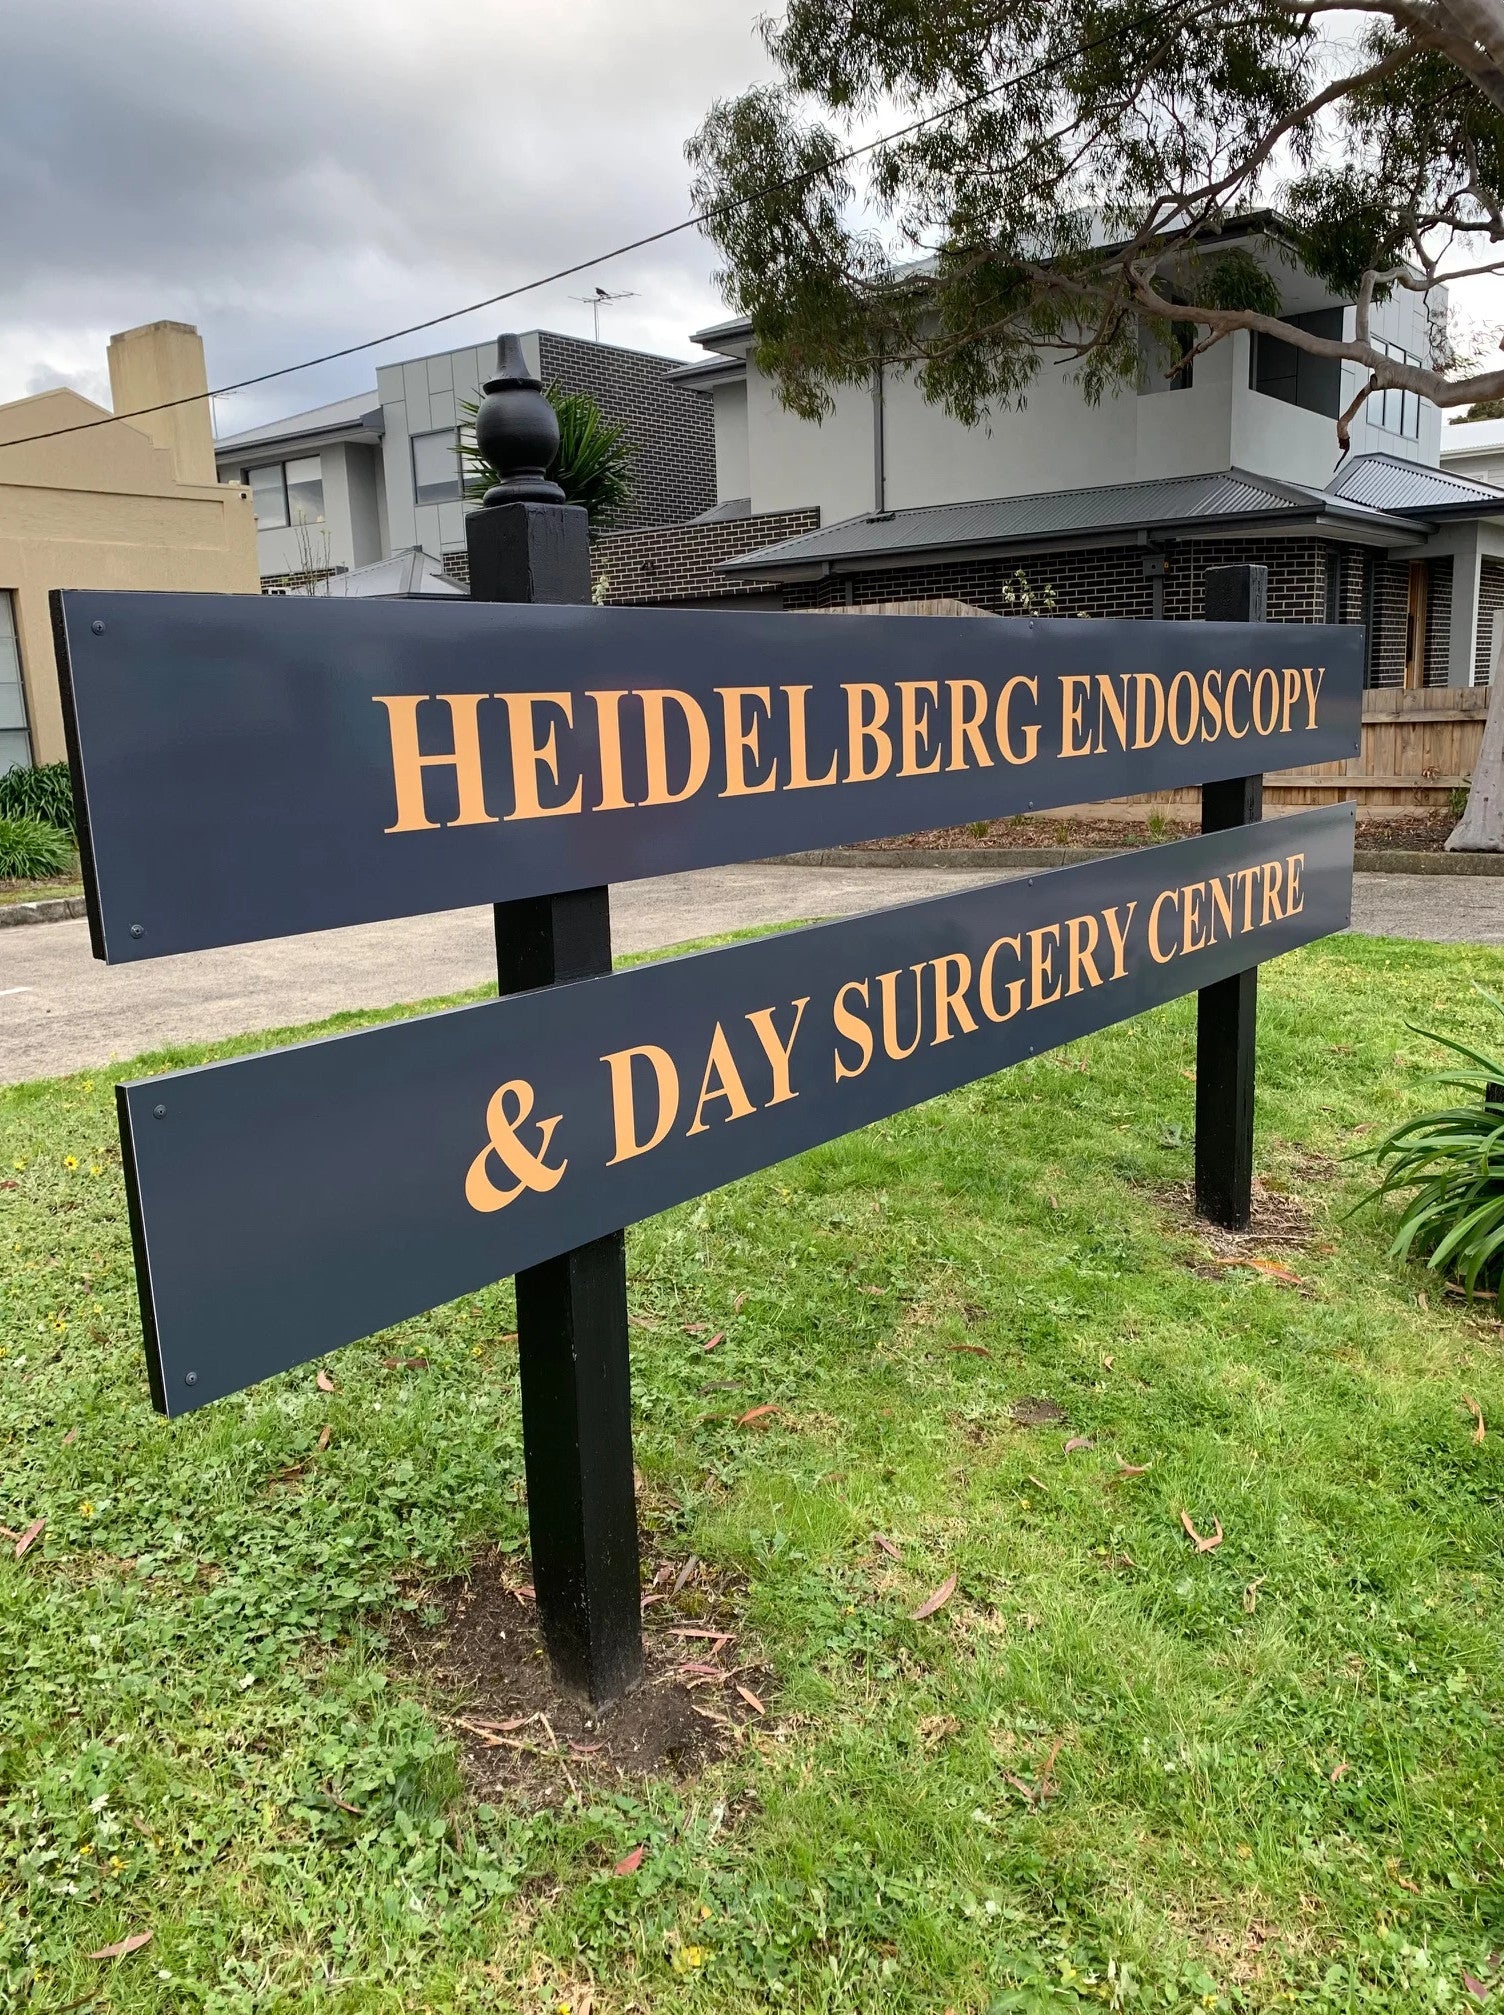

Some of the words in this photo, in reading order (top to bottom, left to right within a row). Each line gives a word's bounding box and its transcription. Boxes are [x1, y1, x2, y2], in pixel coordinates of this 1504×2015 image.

[372, 675, 1040, 834] HEIDELBERG
[1058, 667, 1325, 759] ENDOSCOPY
[464, 1079, 568, 1213] &
[599, 996, 810, 1166] DAY
[833, 901, 1137, 1081] SURGERY
[1147, 853, 1305, 964] CENTRE
